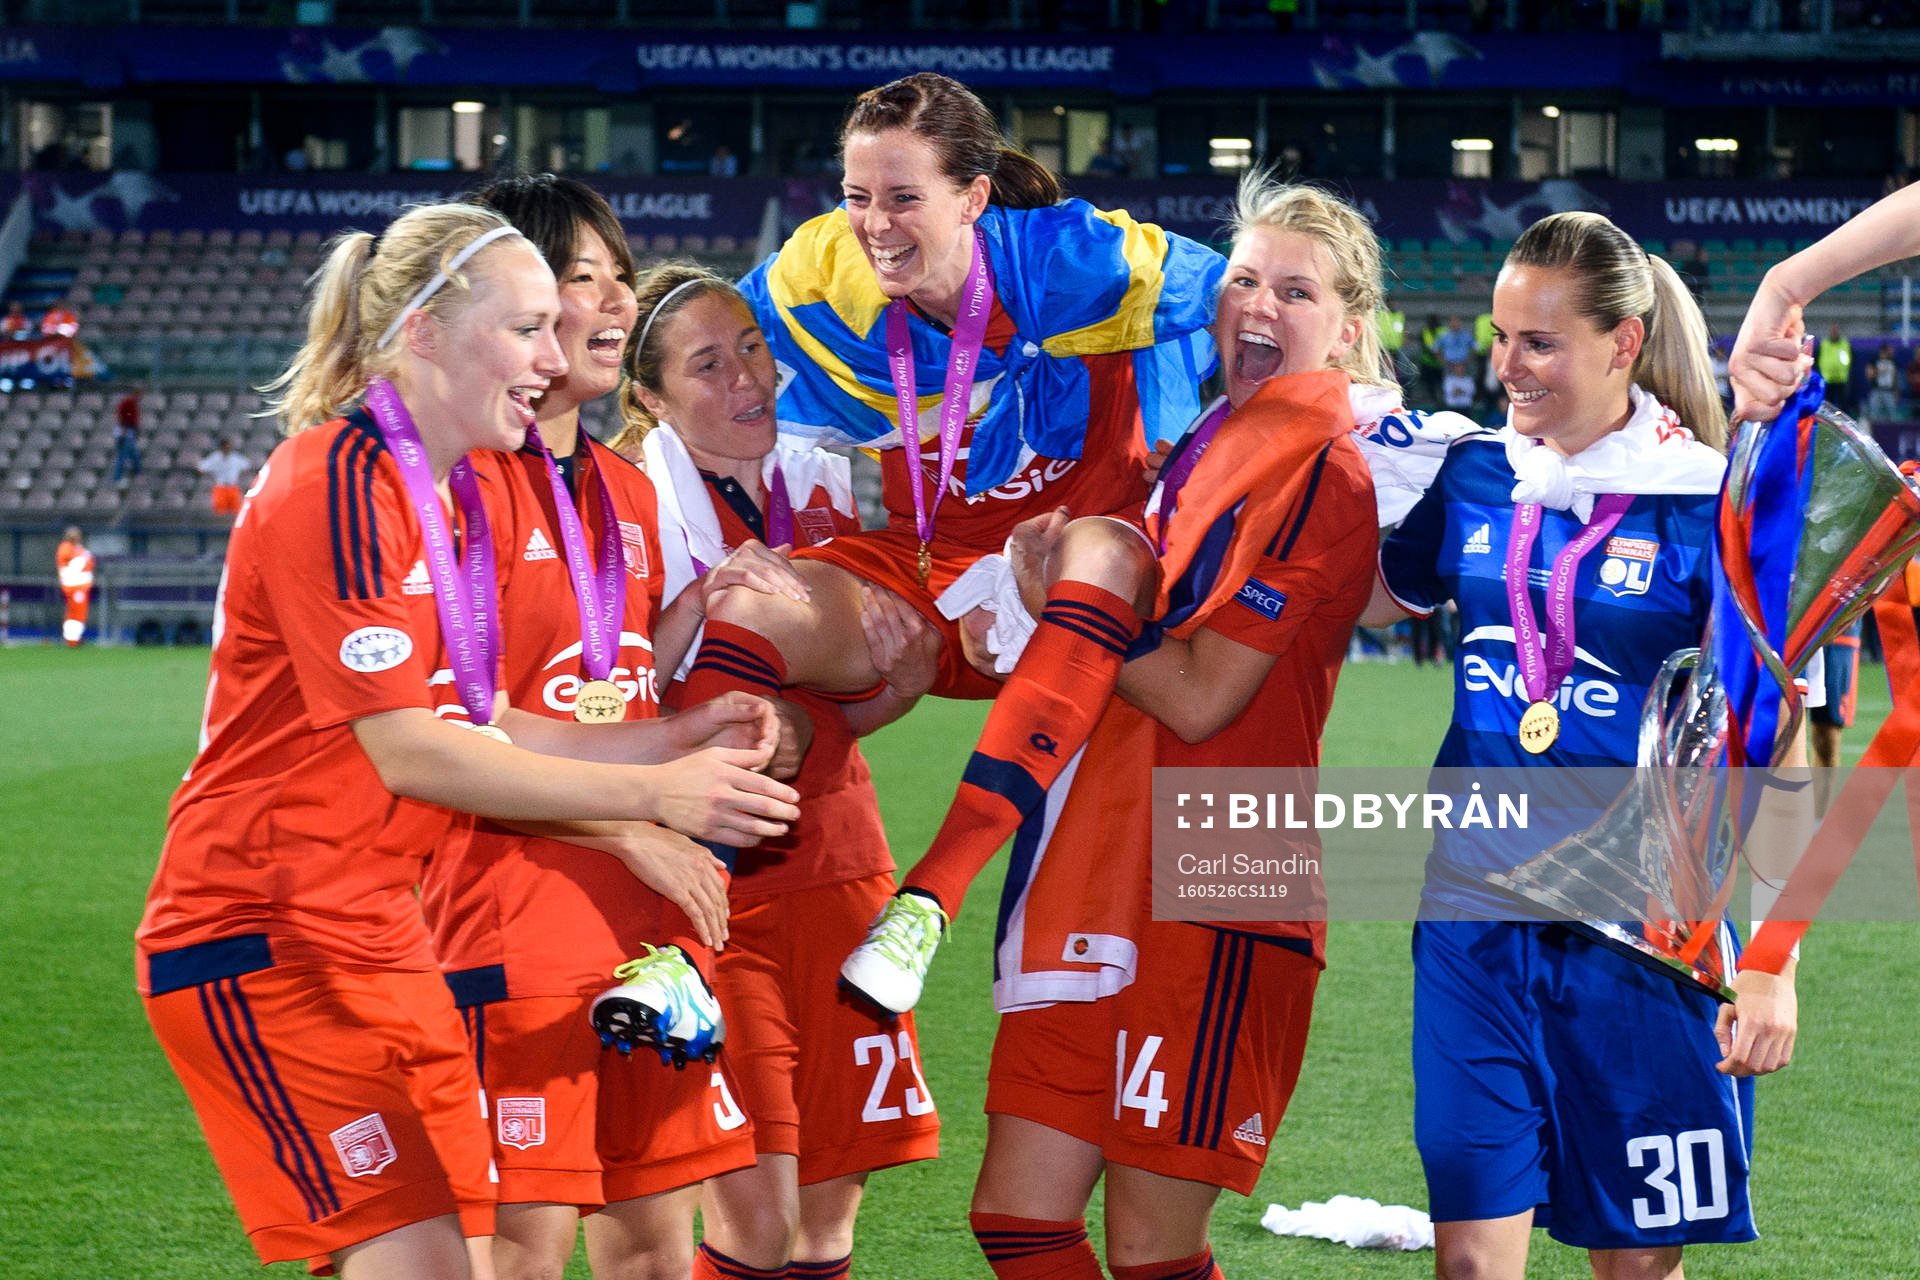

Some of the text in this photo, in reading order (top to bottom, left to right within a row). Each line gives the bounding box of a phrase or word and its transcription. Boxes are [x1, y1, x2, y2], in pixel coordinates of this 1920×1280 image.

[637, 44, 1113, 71] UEFA WOMEN'S CHAMPIONS LEAGUE
[239, 189, 315, 216] UEFA
[316, 190, 440, 216] WOME
[609, 193, 712, 219] LEAGUE
[1665, 197, 1742, 224] UEFA
[967, 277, 985, 318] EMILIA
[895, 348, 909, 387] EMILIA
[949, 382, 963, 414] FINAL
[946, 417, 957, 441] 2016
[470, 544, 484, 577] FINAL
[1605, 545, 1655, 559] LYONNAIS
[1607, 538, 1658, 552] OLYMPIQUE
[423, 502, 475, 672] FINAL 2016 REGGIO EMILIA
[1600, 558, 1647, 591] OL
[471, 582, 486, 609] 2016
[1238, 585, 1284, 613] SPECT
[1554, 525, 1605, 666] FINAL 2016 REGGIO EMILIA
[577, 571, 597, 618] REGGIO
[588, 620, 604, 662] EMILIA
[603, 598, 617, 633] FINAL
[1514, 592, 1532, 641] REGGIO
[1522, 642, 1538, 681] EMILIA
[853, 1030, 935, 1123] 23
[1232, 1130, 1266, 1146] adidas
[1626, 1128, 1729, 1229] 30
